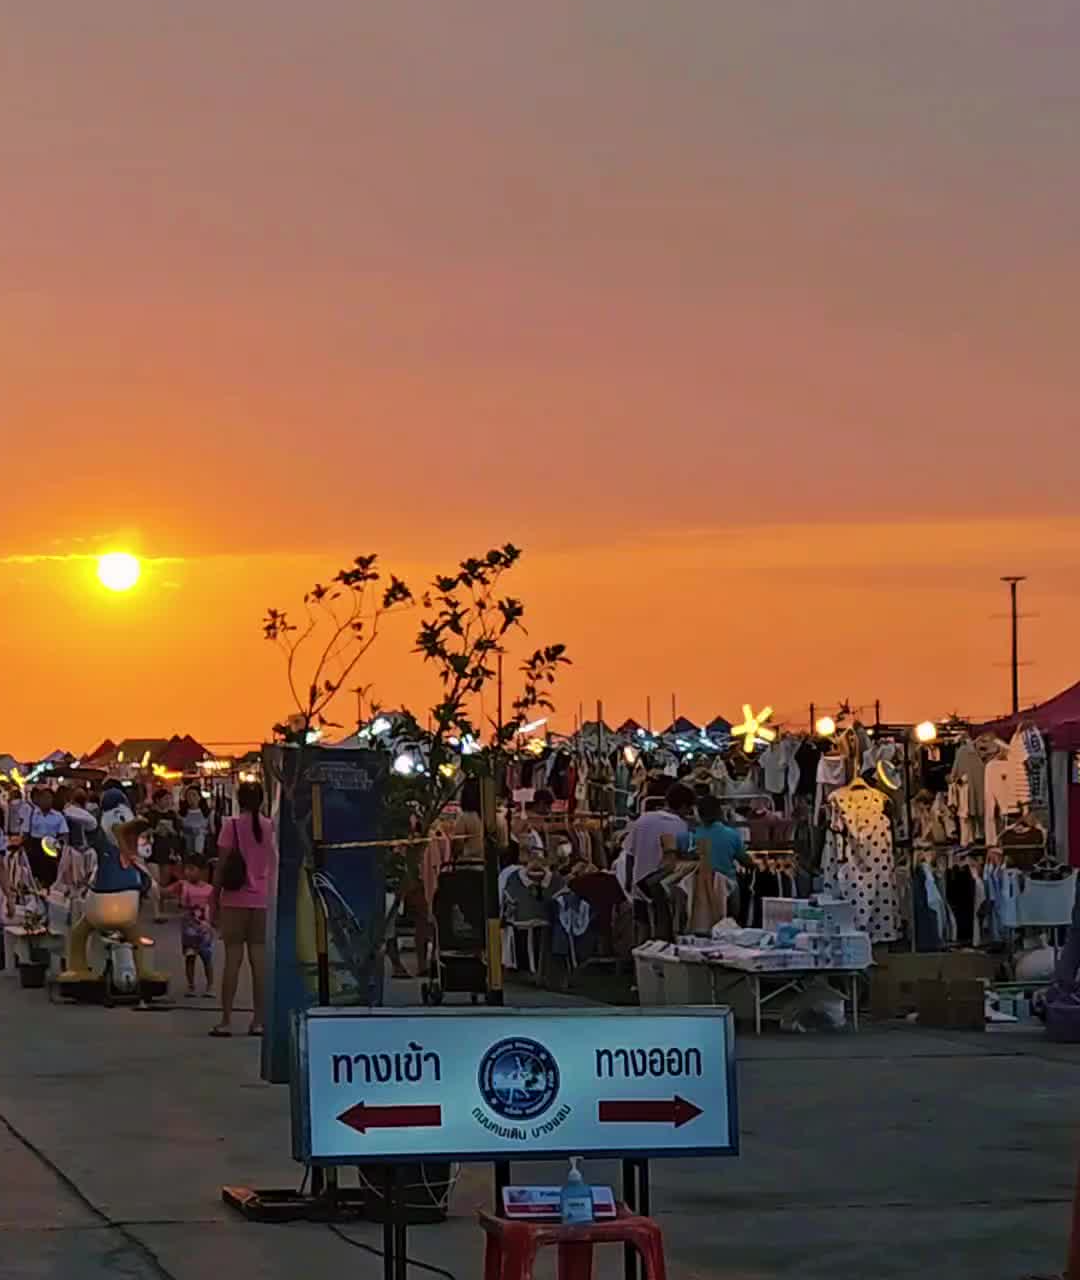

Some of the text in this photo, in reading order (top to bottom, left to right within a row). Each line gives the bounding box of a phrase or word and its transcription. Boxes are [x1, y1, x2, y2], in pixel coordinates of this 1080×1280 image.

[331, 1041, 441, 1084] ทางเข้า
[594, 1046, 703, 1078] ทางออก
